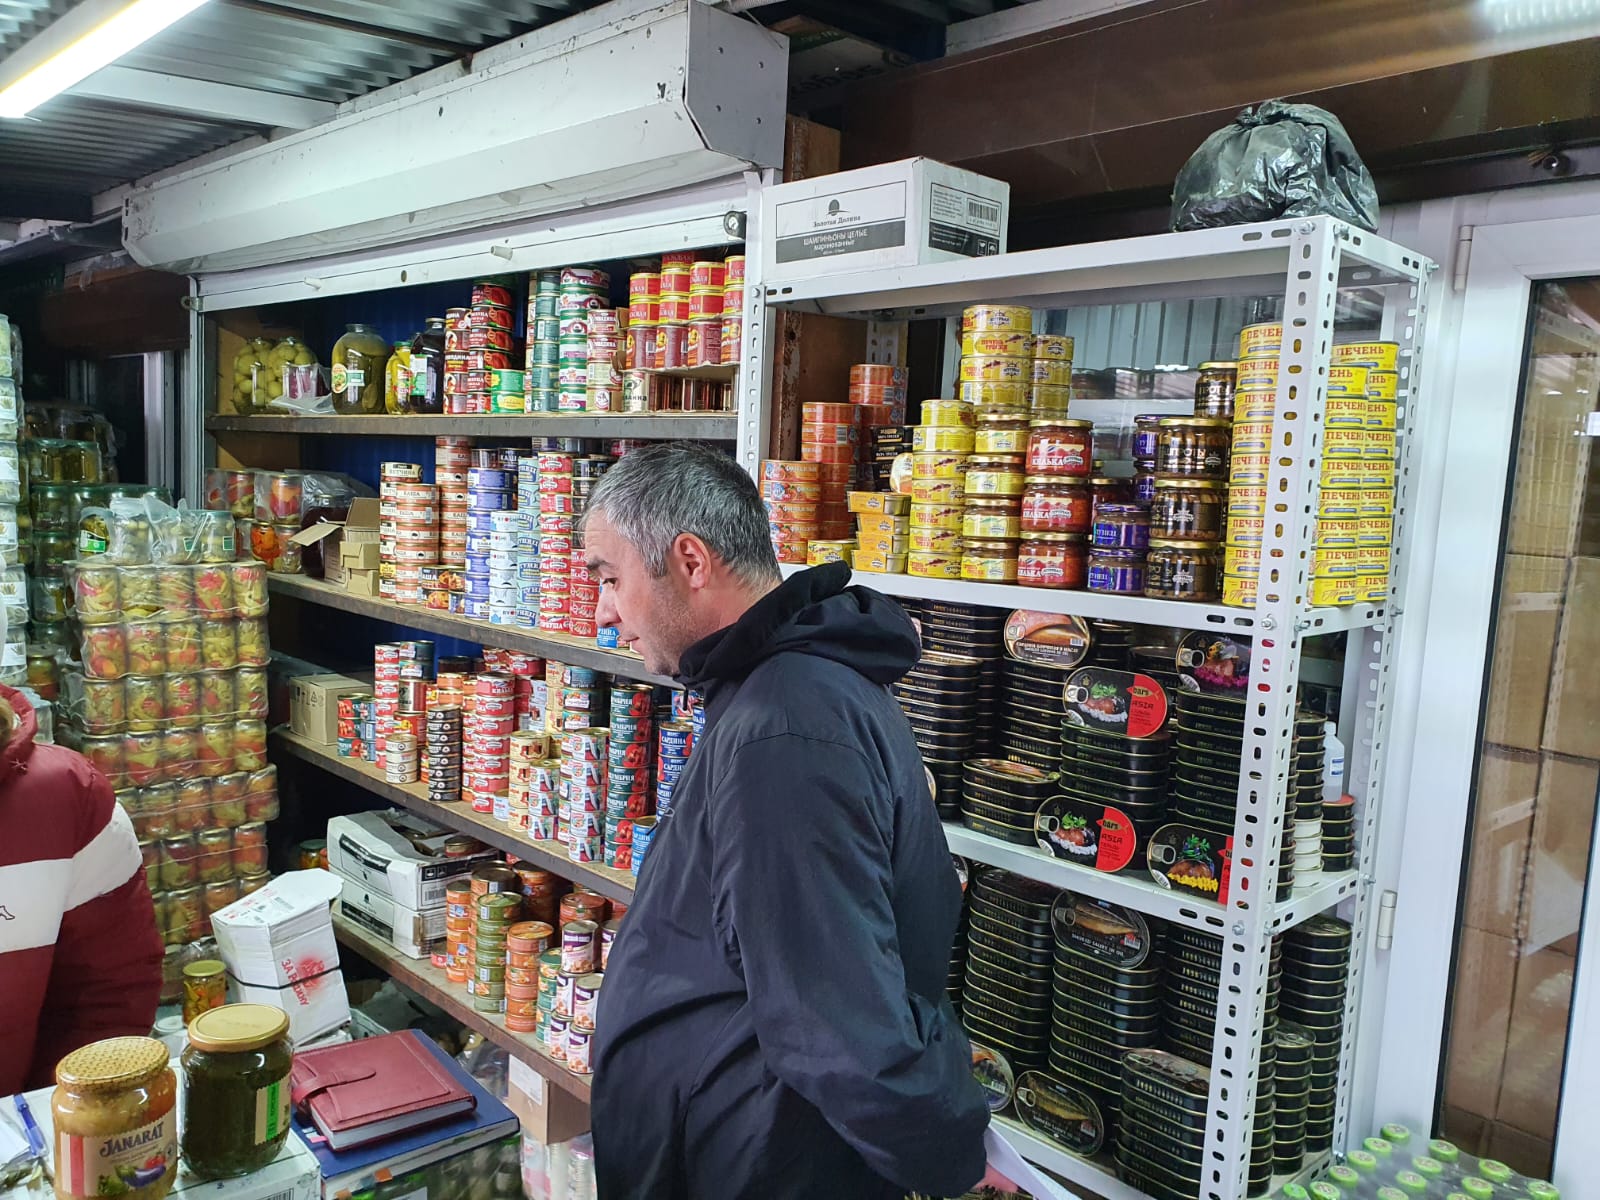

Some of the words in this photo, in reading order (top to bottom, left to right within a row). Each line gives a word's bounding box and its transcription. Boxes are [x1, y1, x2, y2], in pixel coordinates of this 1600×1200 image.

[1246, 327, 1283, 339] ПЕЧЕН
[1336, 346, 1385, 356] ПЕЧЕНЬ
[1329, 369, 1353, 378] ЕНЬ
[1244, 393, 1275, 403] ПЕЧЕ
[1367, 403, 1388, 413] ЕНЬ
[1326, 431, 1364, 440] ПЕЧЕН
[1366, 433, 1393, 442] ЧЕНЬ
[1327, 461, 1362, 471] ПЕЧЕН
[1364, 463, 1390, 471] ЧЕНЬ
[1362, 491, 1390, 500] ЧЕНЬ
[1360, 520, 1390, 529] ЕЧЕНЬ
[1236, 549, 1262, 559] ПЕЧ
[1360, 549, 1389, 558] ЕЧЕНЬ
[1365, 577, 1389, 586] ПЕЧЕ
[281, 958, 294, 974] ЗА
[99, 1121, 164, 1158] JANARAT
